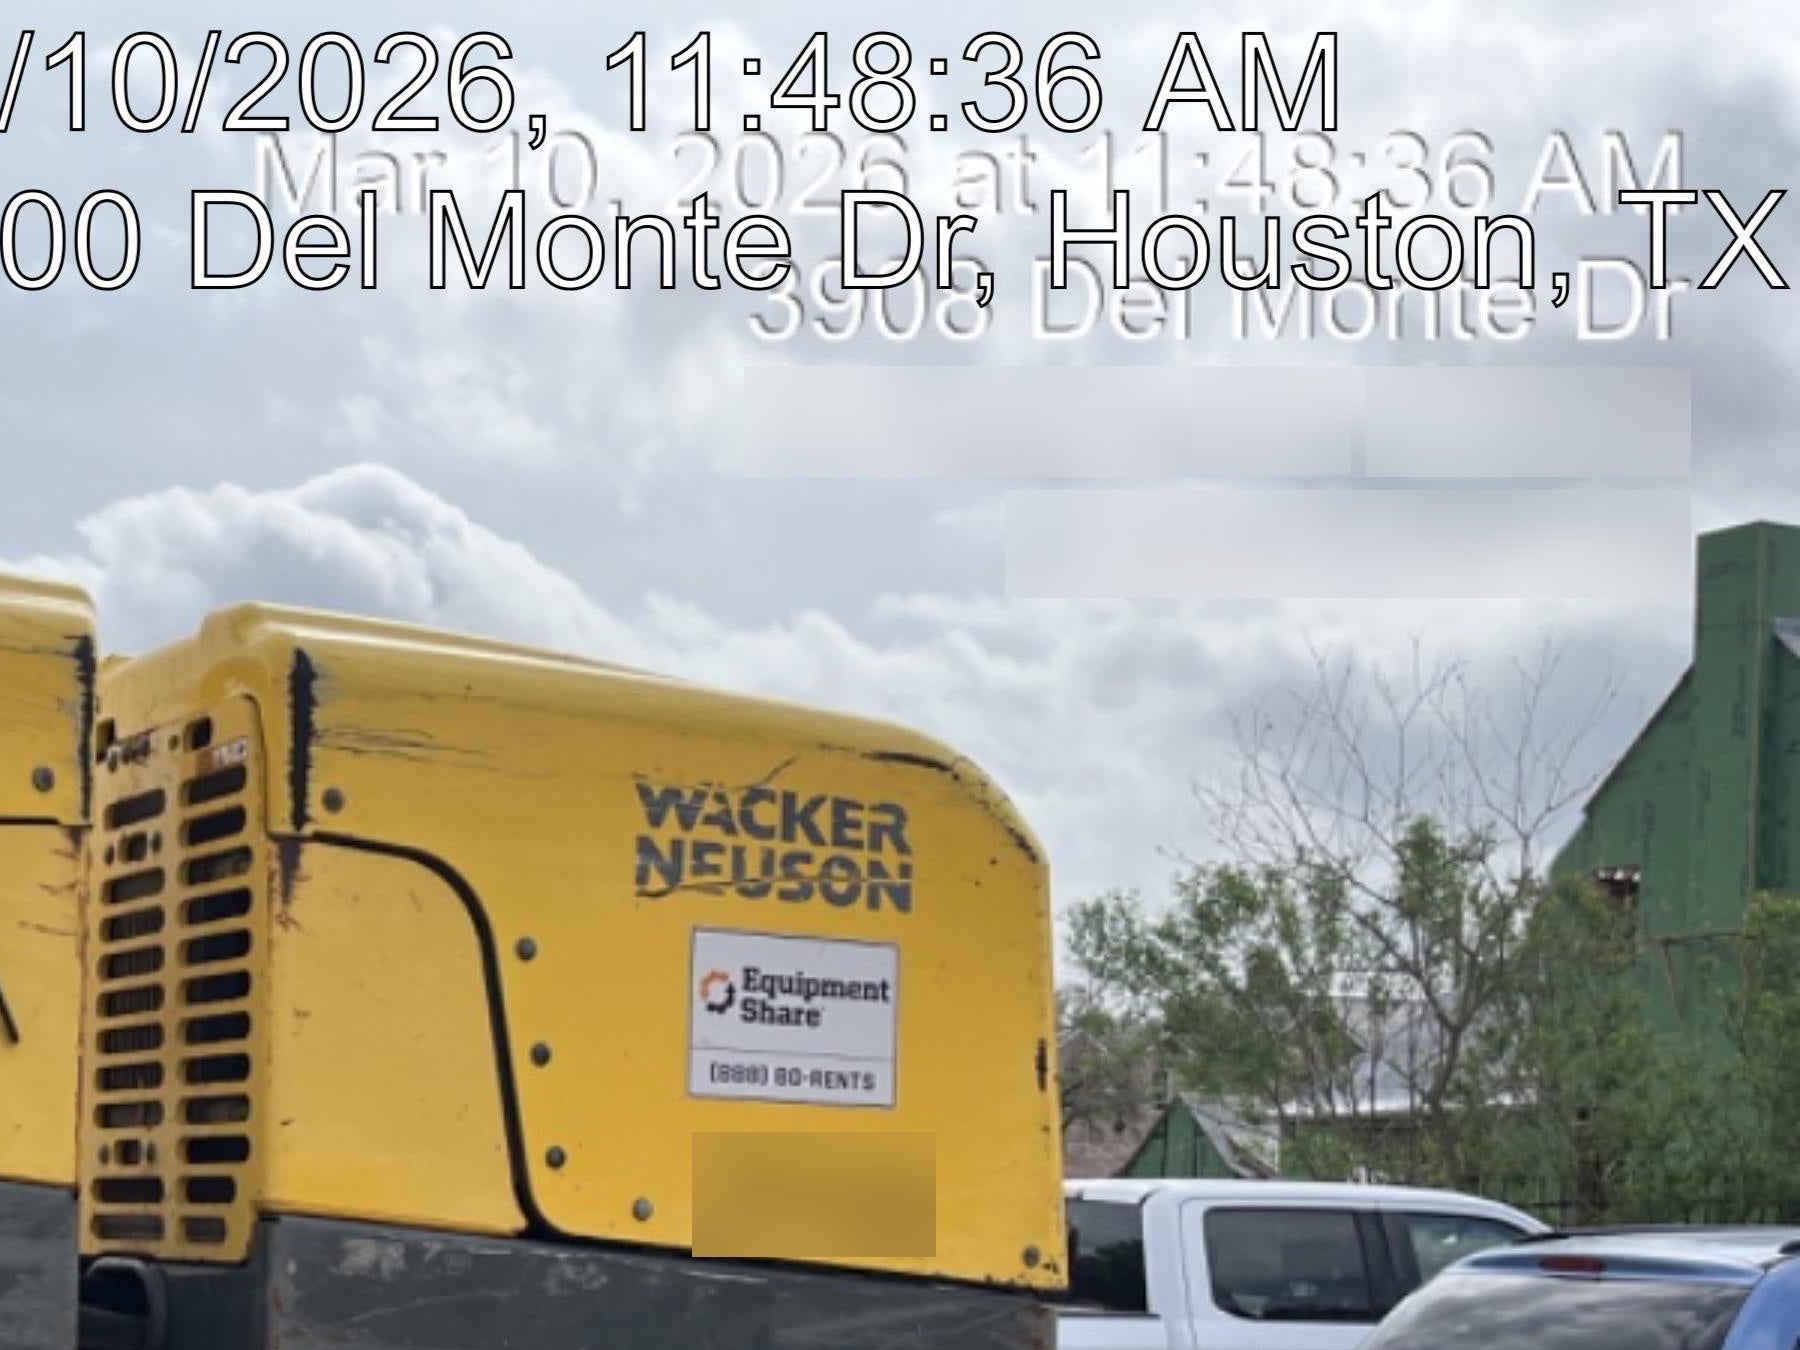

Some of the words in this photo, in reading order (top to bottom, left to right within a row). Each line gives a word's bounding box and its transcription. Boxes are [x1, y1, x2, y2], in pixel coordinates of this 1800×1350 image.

[635, 782, 912, 855] WACKER
[635, 834, 912, 914] NEUSON
[741, 966, 890, 1002] Equipment
[739, 997, 822, 1028] Share
[710, 1060, 769, 1086] (888)
[774, 1066, 877, 1091] 80-RENTS
